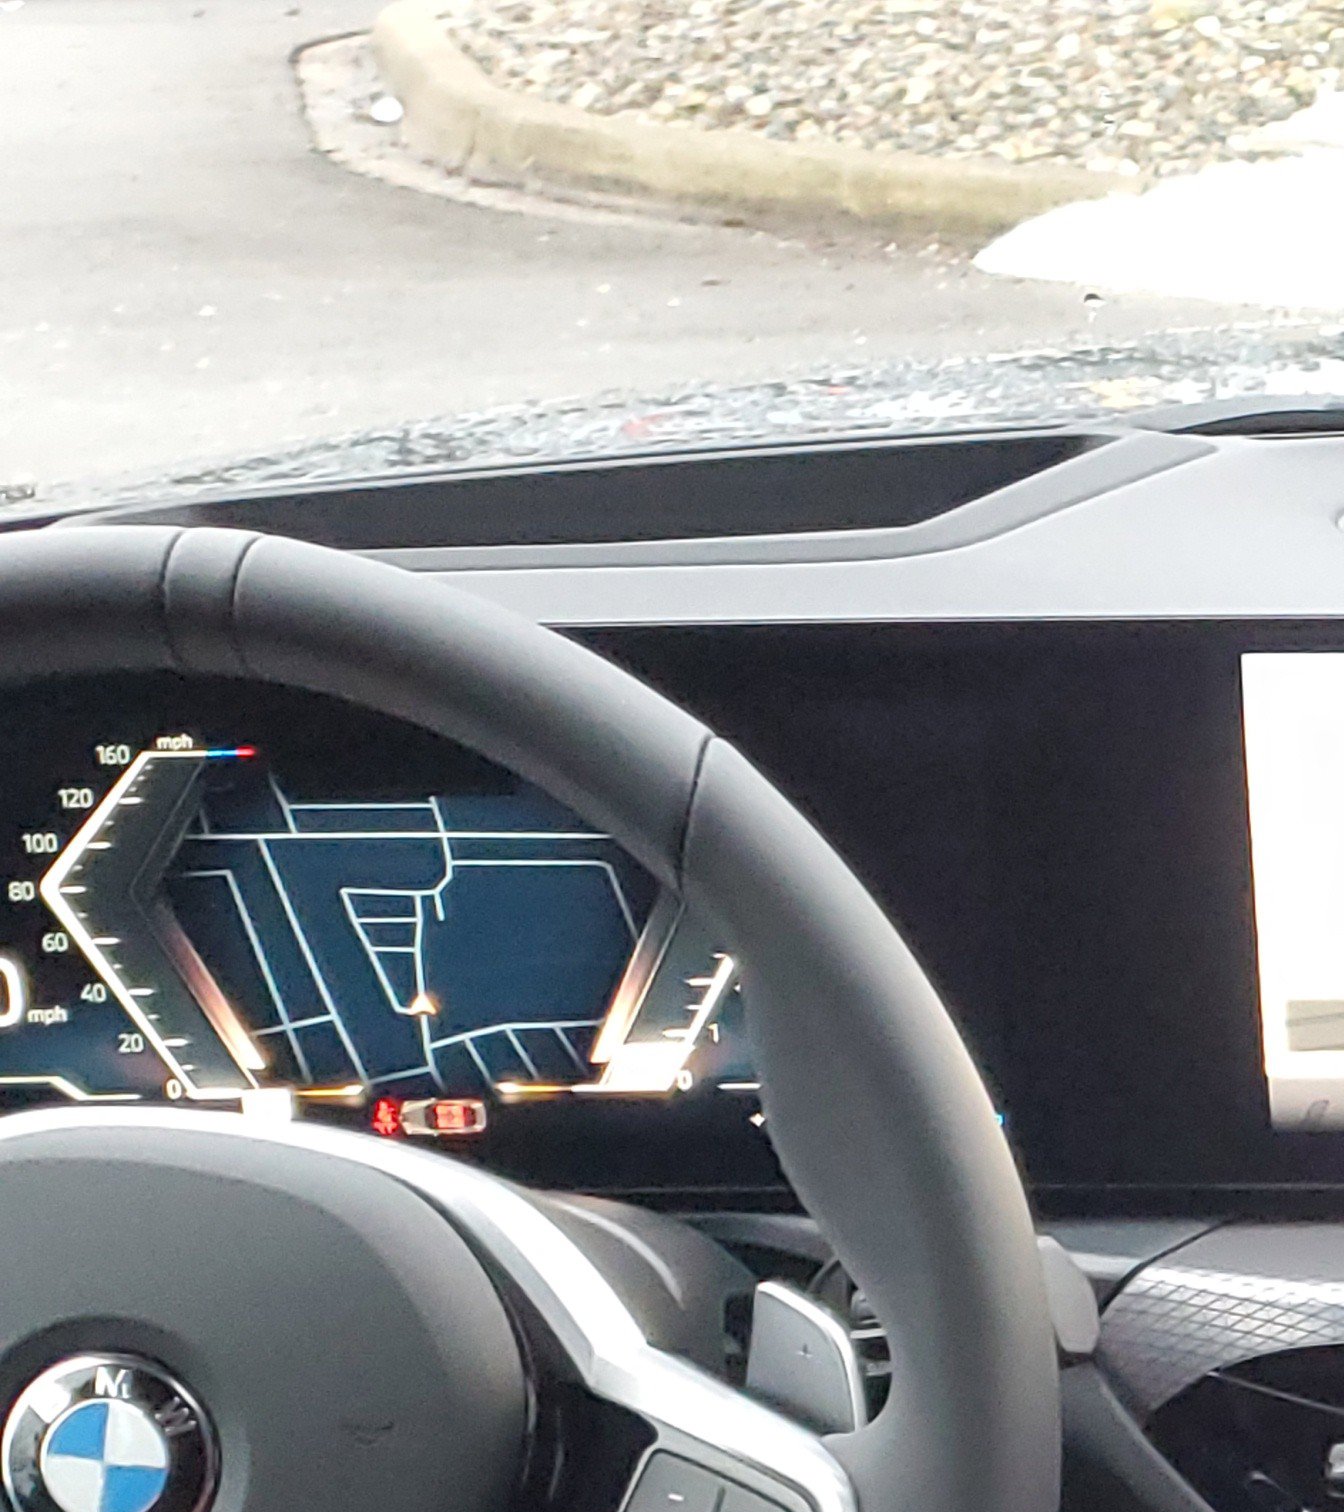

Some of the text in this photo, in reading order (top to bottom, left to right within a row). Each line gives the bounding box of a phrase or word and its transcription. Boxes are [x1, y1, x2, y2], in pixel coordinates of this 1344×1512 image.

[156, 734, 193, 750] mph
[95, 745, 131, 765] 160
[58, 788, 94, 808] 120
[21, 833, 58, 853] 100
[8, 881, 35, 901] 80
[41, 932, 69, 952] 60
[80, 983, 107, 1003] 40
[27, 1005, 68, 1027] mph
[118, 1033, 144, 1053] 20
[166, 1078, 182, 1099] 0
[676, 1070, 693, 1091] 0
